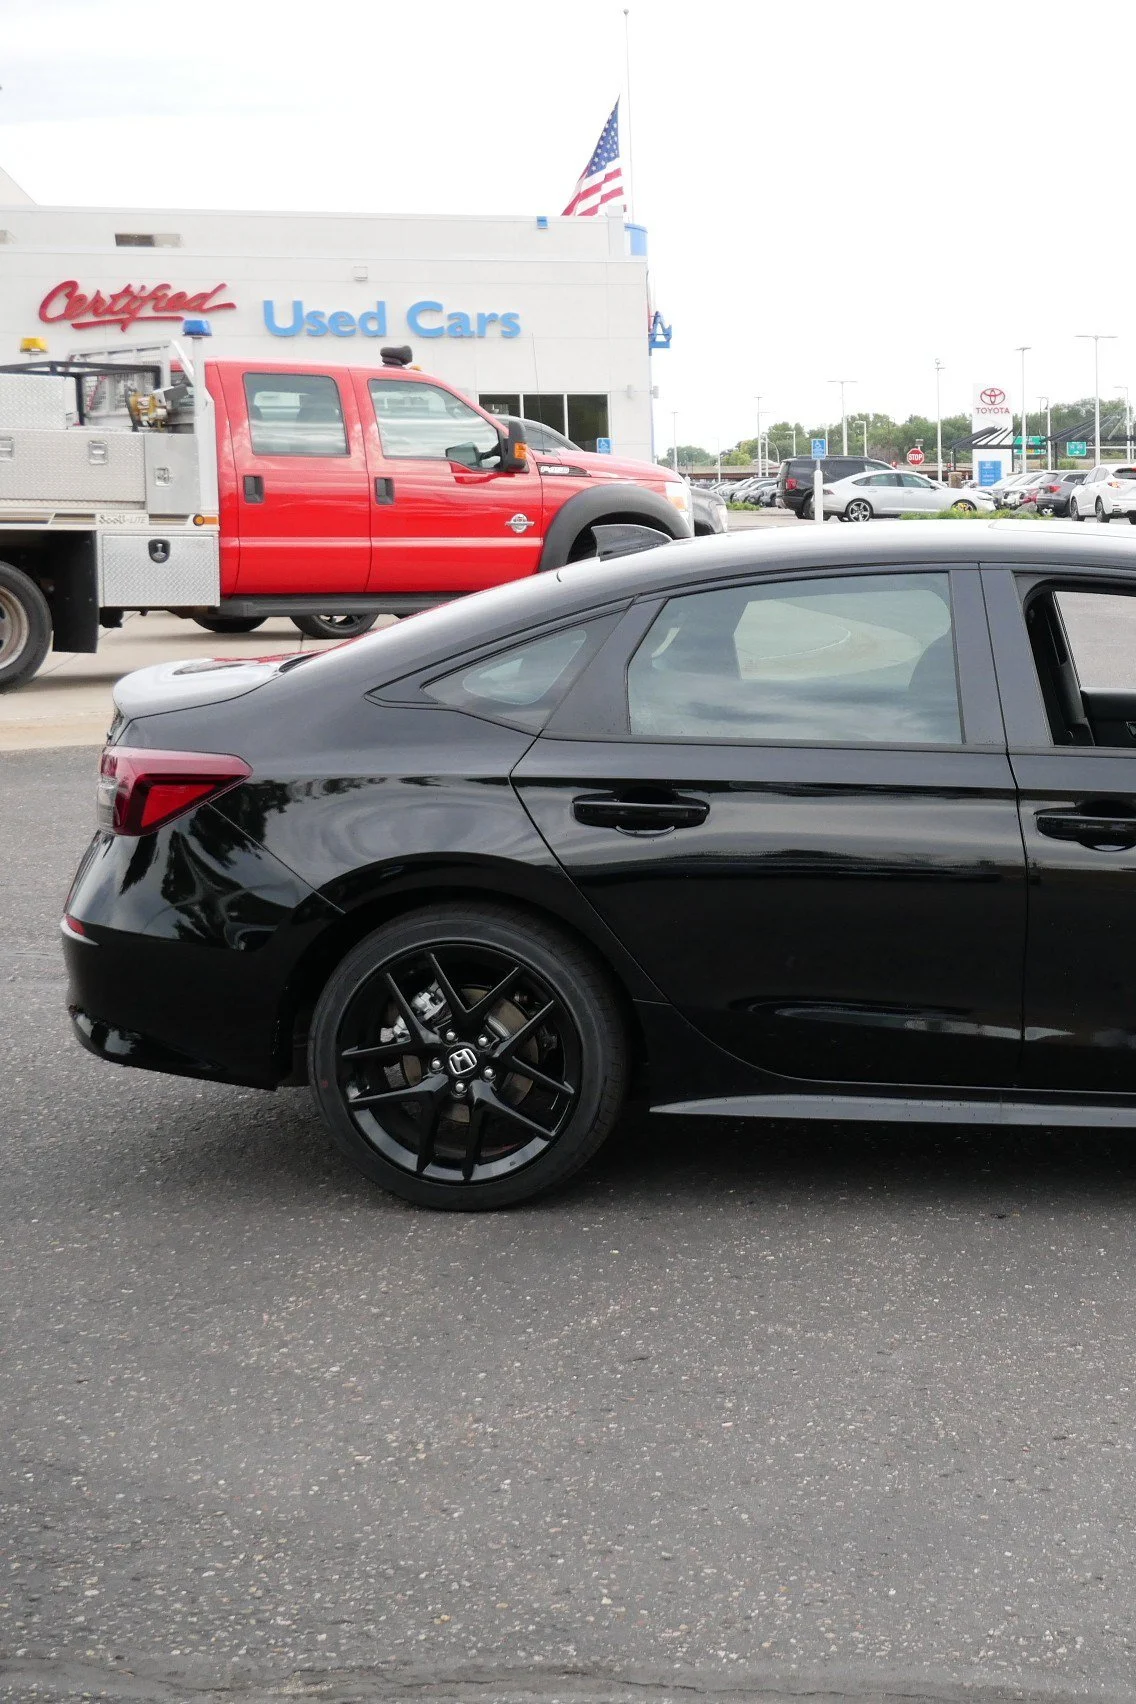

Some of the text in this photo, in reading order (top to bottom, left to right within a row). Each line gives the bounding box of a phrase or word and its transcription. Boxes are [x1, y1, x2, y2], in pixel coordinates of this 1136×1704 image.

[38, 280, 237, 332] Certified
[263, 300, 522, 338] Used Cars
[908, 453, 923, 461] STOP
